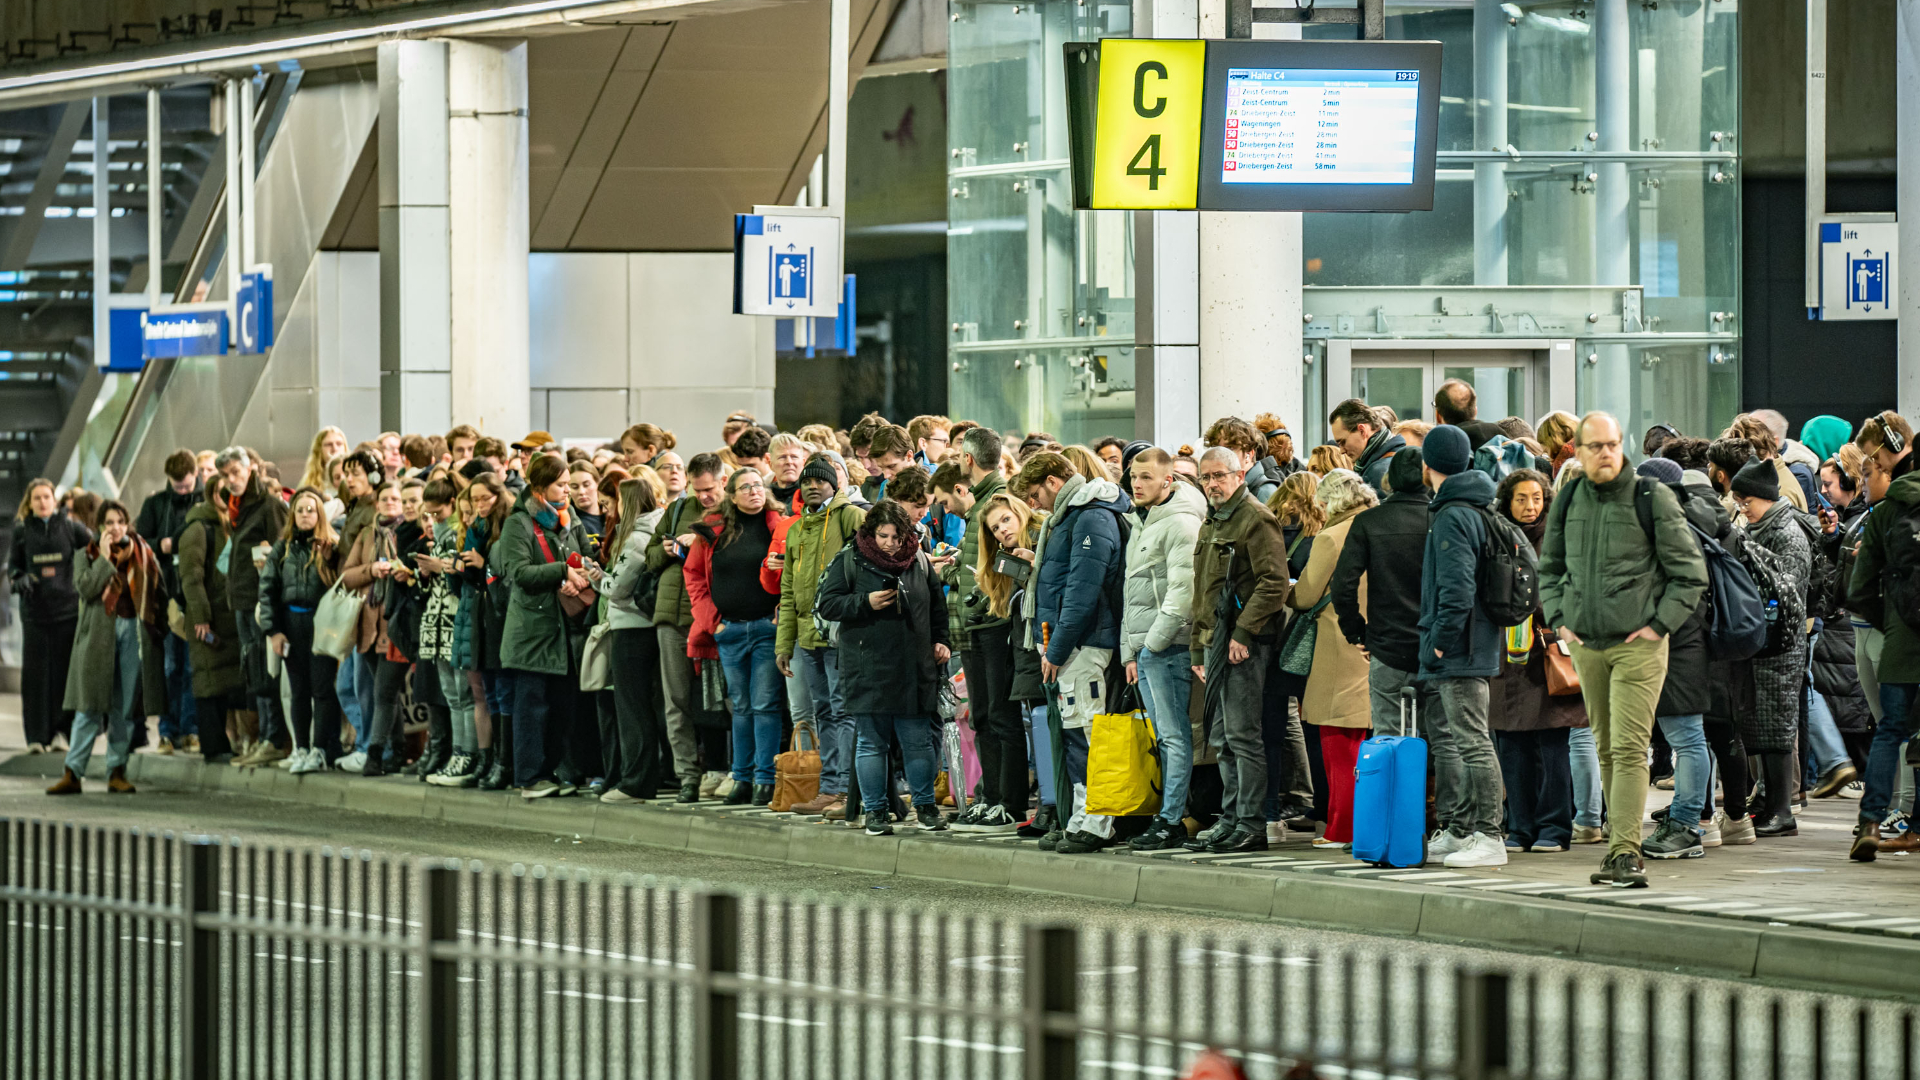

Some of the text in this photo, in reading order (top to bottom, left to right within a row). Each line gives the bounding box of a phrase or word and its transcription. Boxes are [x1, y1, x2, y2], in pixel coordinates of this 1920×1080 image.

[1250, 71, 1285, 80] Halte C4
[1133, 61, 1168, 118] C
[1241, 98, 1288, 106] Zeist-Centrum
[1228, 119, 1238, 127] 50
[1241, 120, 1281, 129] Wageningen
[1227, 130, 1237, 138] 50
[1226, 140, 1236, 148] 50
[1316, 141, 1324, 149] 28
[1126, 134, 1167, 190] 4
[1225, 161, 1235, 169] 50
[1238, 162, 1293, 171] Driebergen-Zeist
[1314, 162, 1323, 170] 58
[766, 223, 782, 233] lift
[1844, 230, 1858, 240] lift
[241, 301, 253, 348] C
